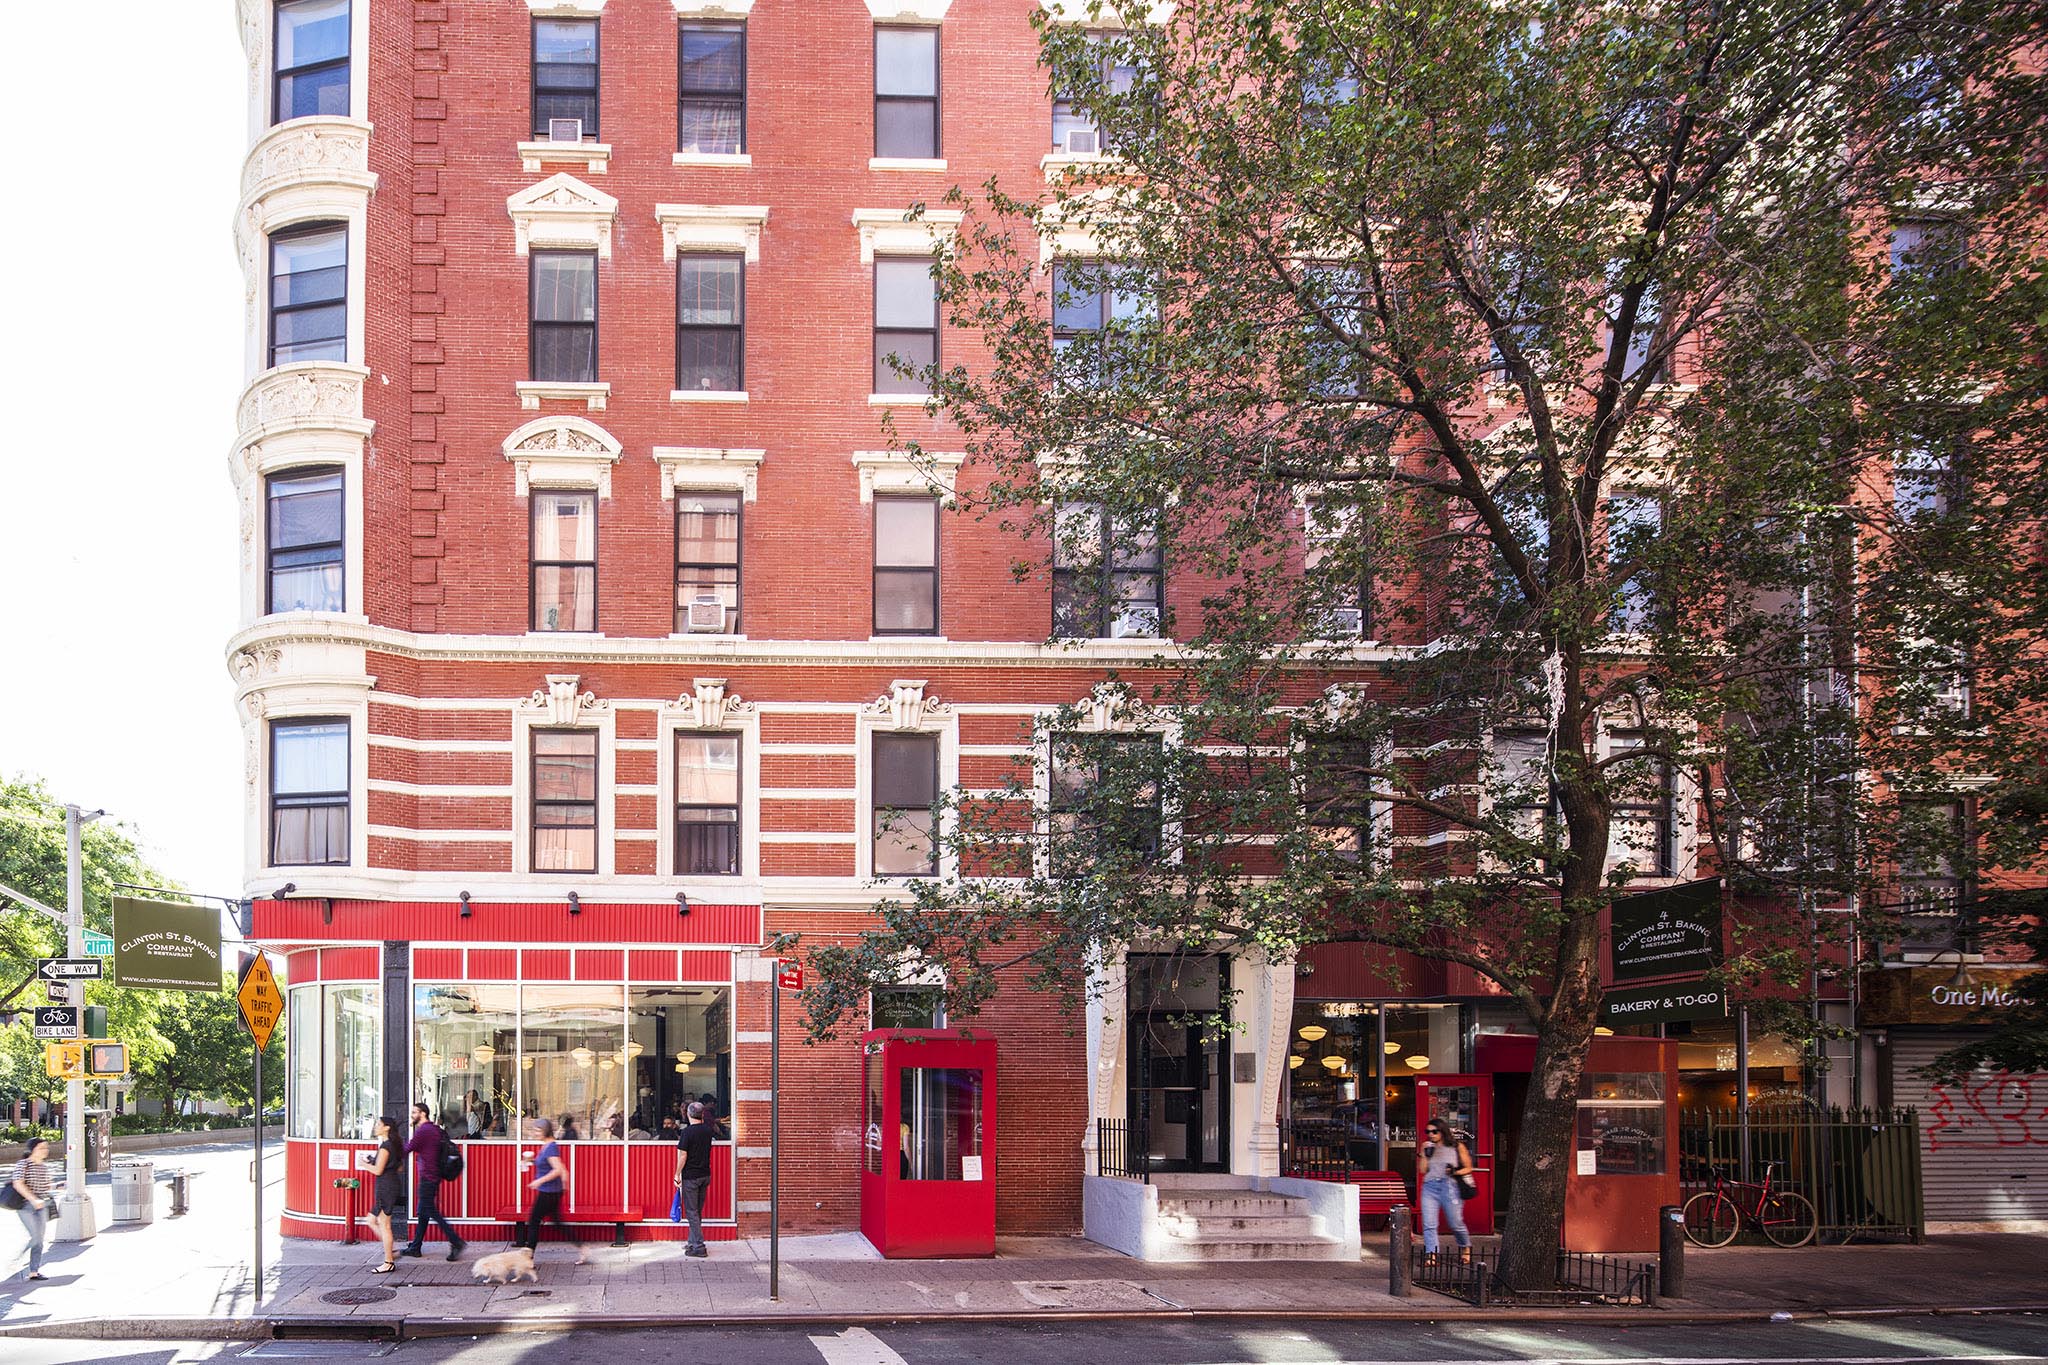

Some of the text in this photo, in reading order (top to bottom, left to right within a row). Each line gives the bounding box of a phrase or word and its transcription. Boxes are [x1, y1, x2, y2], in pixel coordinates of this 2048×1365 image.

[1659, 910, 1669, 920] 4
[1617, 920, 1711, 951] CLINTON ST. BAKING
[1639, 930, 1686, 944] COMPANY
[85, 940, 114, 955] Clint
[120, 932, 164, 952] CLINTON
[165, 931, 181, 941] ST.
[183, 933, 218, 960] BAKING
[146, 943, 195, 953] COMPANY
[1645, 938, 1685, 948] RESTAURANT
[47, 965, 94, 974] ONE WAY
[255, 968, 268, 982] TWO
[121, 976, 219, 987] WWW.CLINTONSTREETBAKING.COM
[52, 986, 65, 996] ONE
[255, 984, 267, 997] WAY
[1931, 985, 1976, 1005] One
[250, 998, 273, 1014] TRAFFIC
[1610, 992, 1719, 1014] BAKERY & TO-GO
[253, 1015, 271, 1029] AHEAD
[36, 1027, 76, 1036] BIKE LANE
[1747, 1090, 1777, 1108] CLINTON
[1792, 1089, 1820, 1108] BAKING
